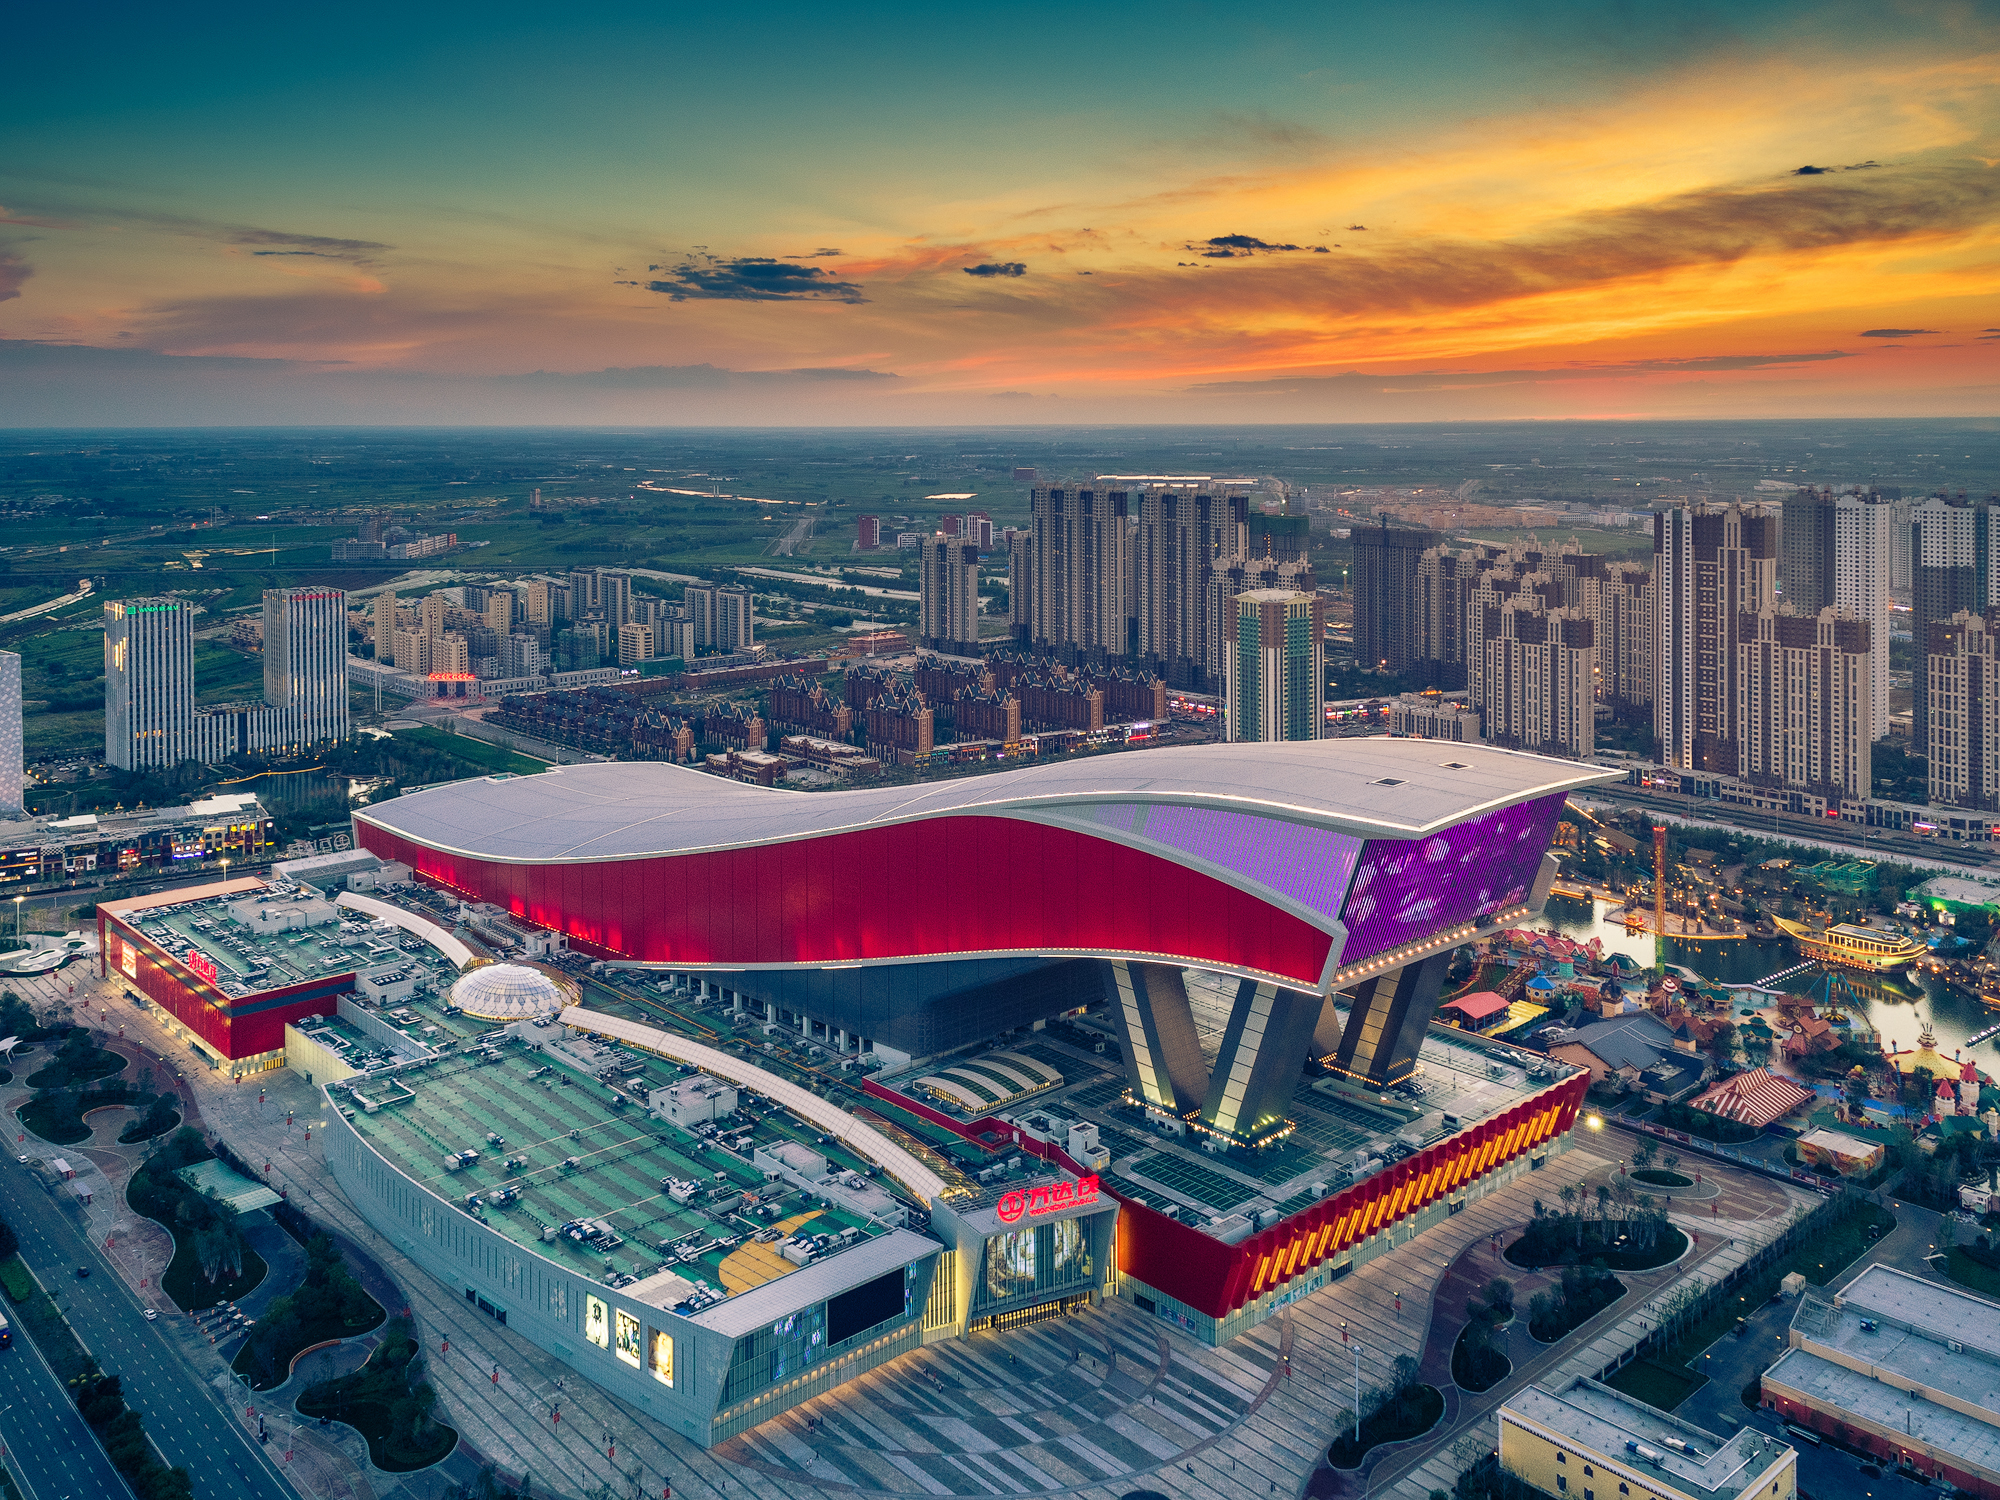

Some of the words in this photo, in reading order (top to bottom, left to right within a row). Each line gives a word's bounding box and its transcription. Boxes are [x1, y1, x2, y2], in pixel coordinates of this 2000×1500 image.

[1027, 1174, 1099, 1208] 万达茂
[1029, 1203, 1067, 1217] WANDA
[1068, 1196, 1099, 1208] MALL
